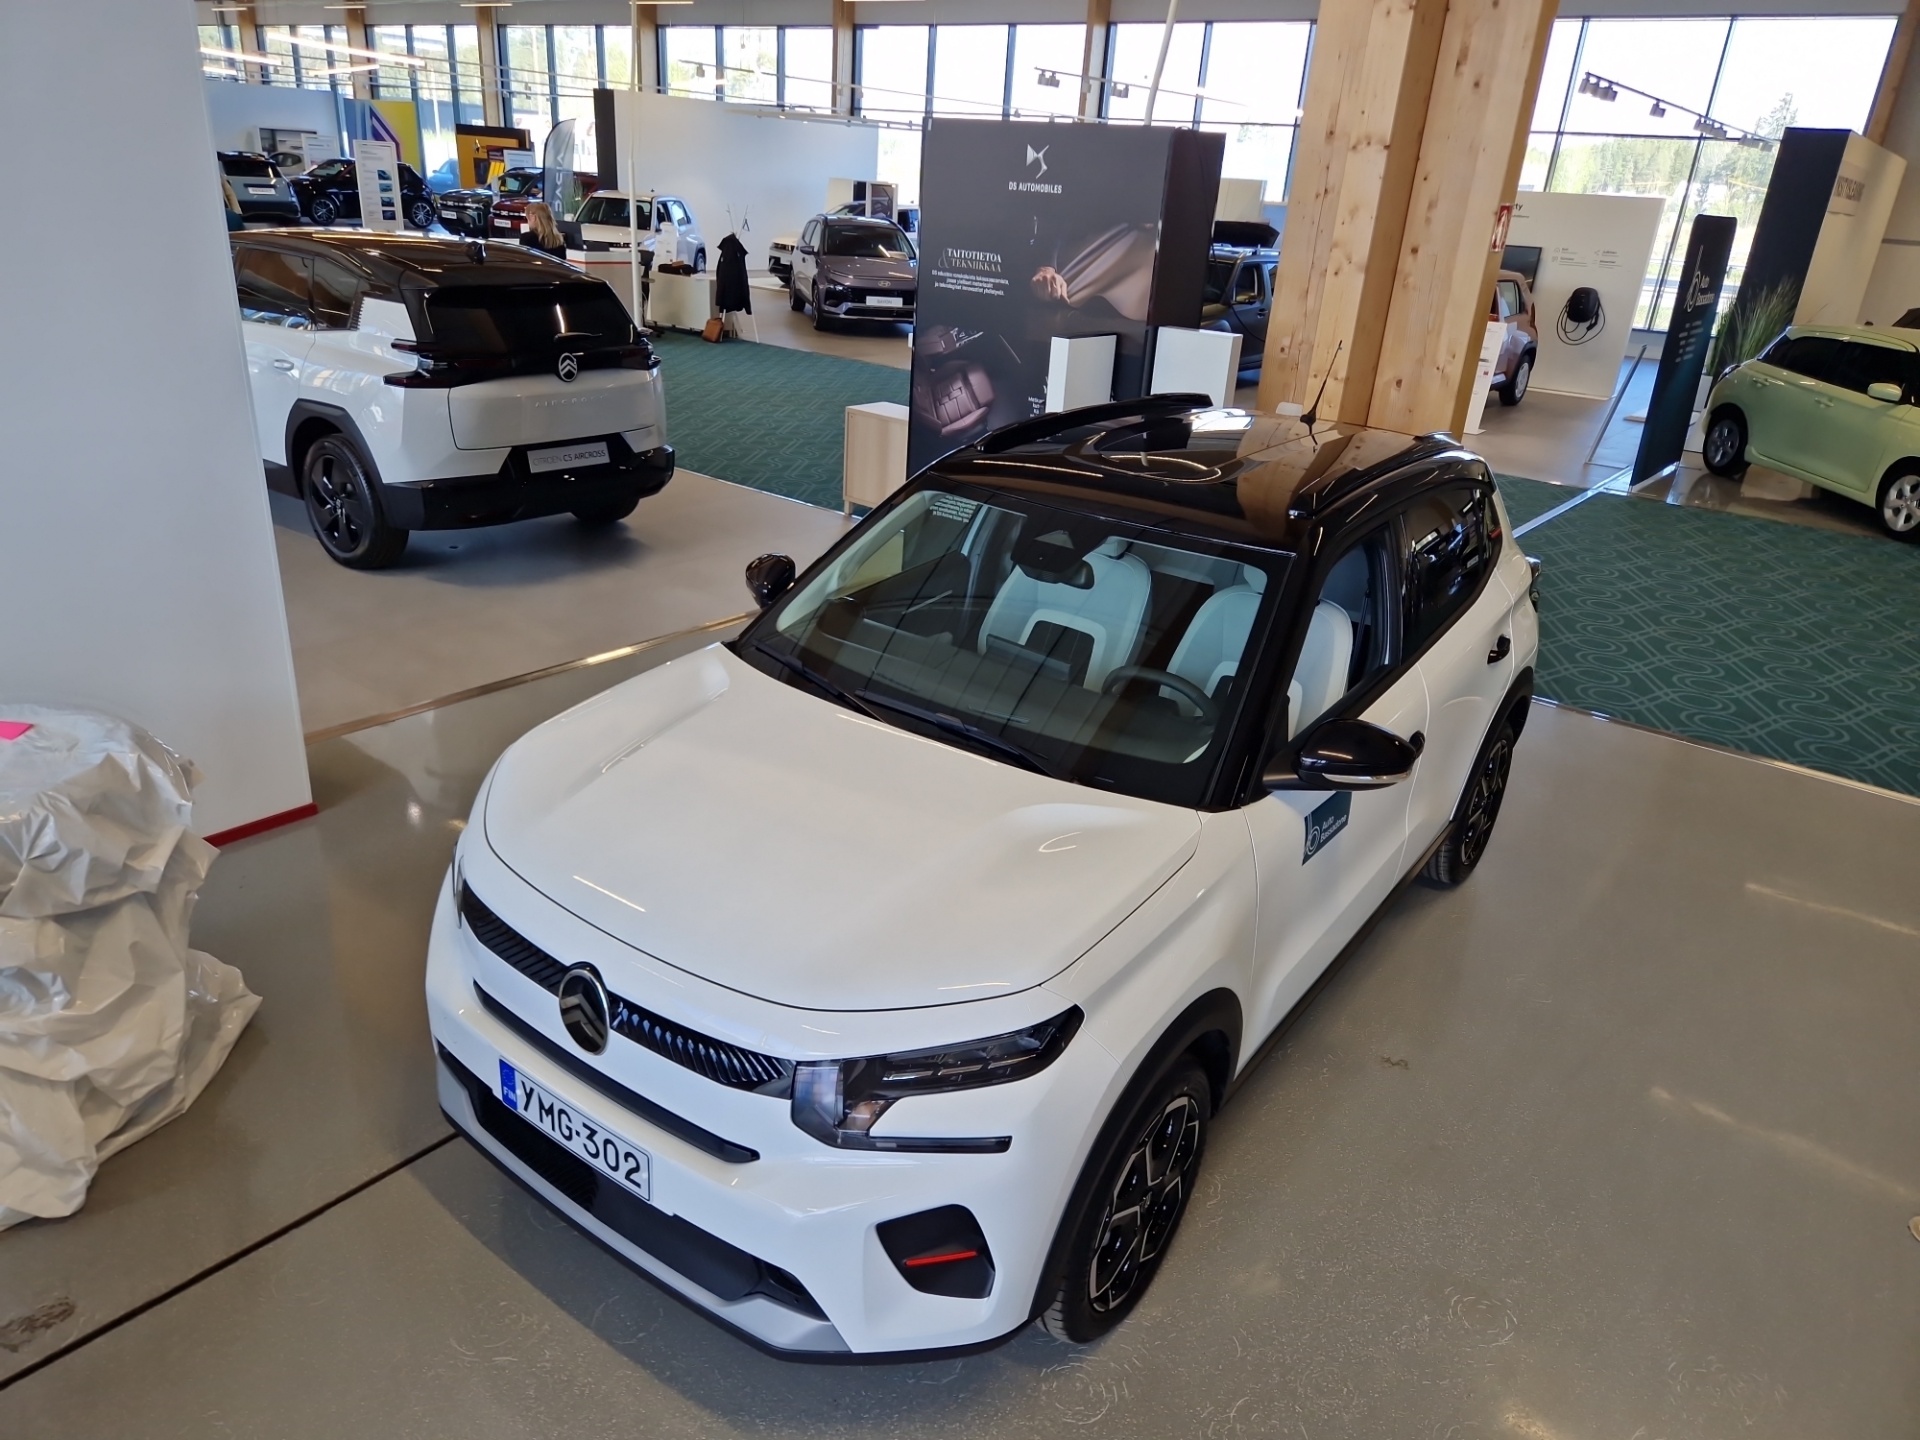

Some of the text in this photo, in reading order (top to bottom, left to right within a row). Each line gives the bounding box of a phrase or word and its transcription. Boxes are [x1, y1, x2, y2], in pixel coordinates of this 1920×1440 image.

[1008, 181, 1062, 194] DS AUTOMOBILES
[947, 247, 1001, 263] TAITOTIETOA
[951, 258, 1001, 272] TEKNIIKKAA
[574, 449, 606, 461] AIRCROSS
[503, 1086, 517, 1103] FIN
[520, 1080, 642, 1190] YMG-302
